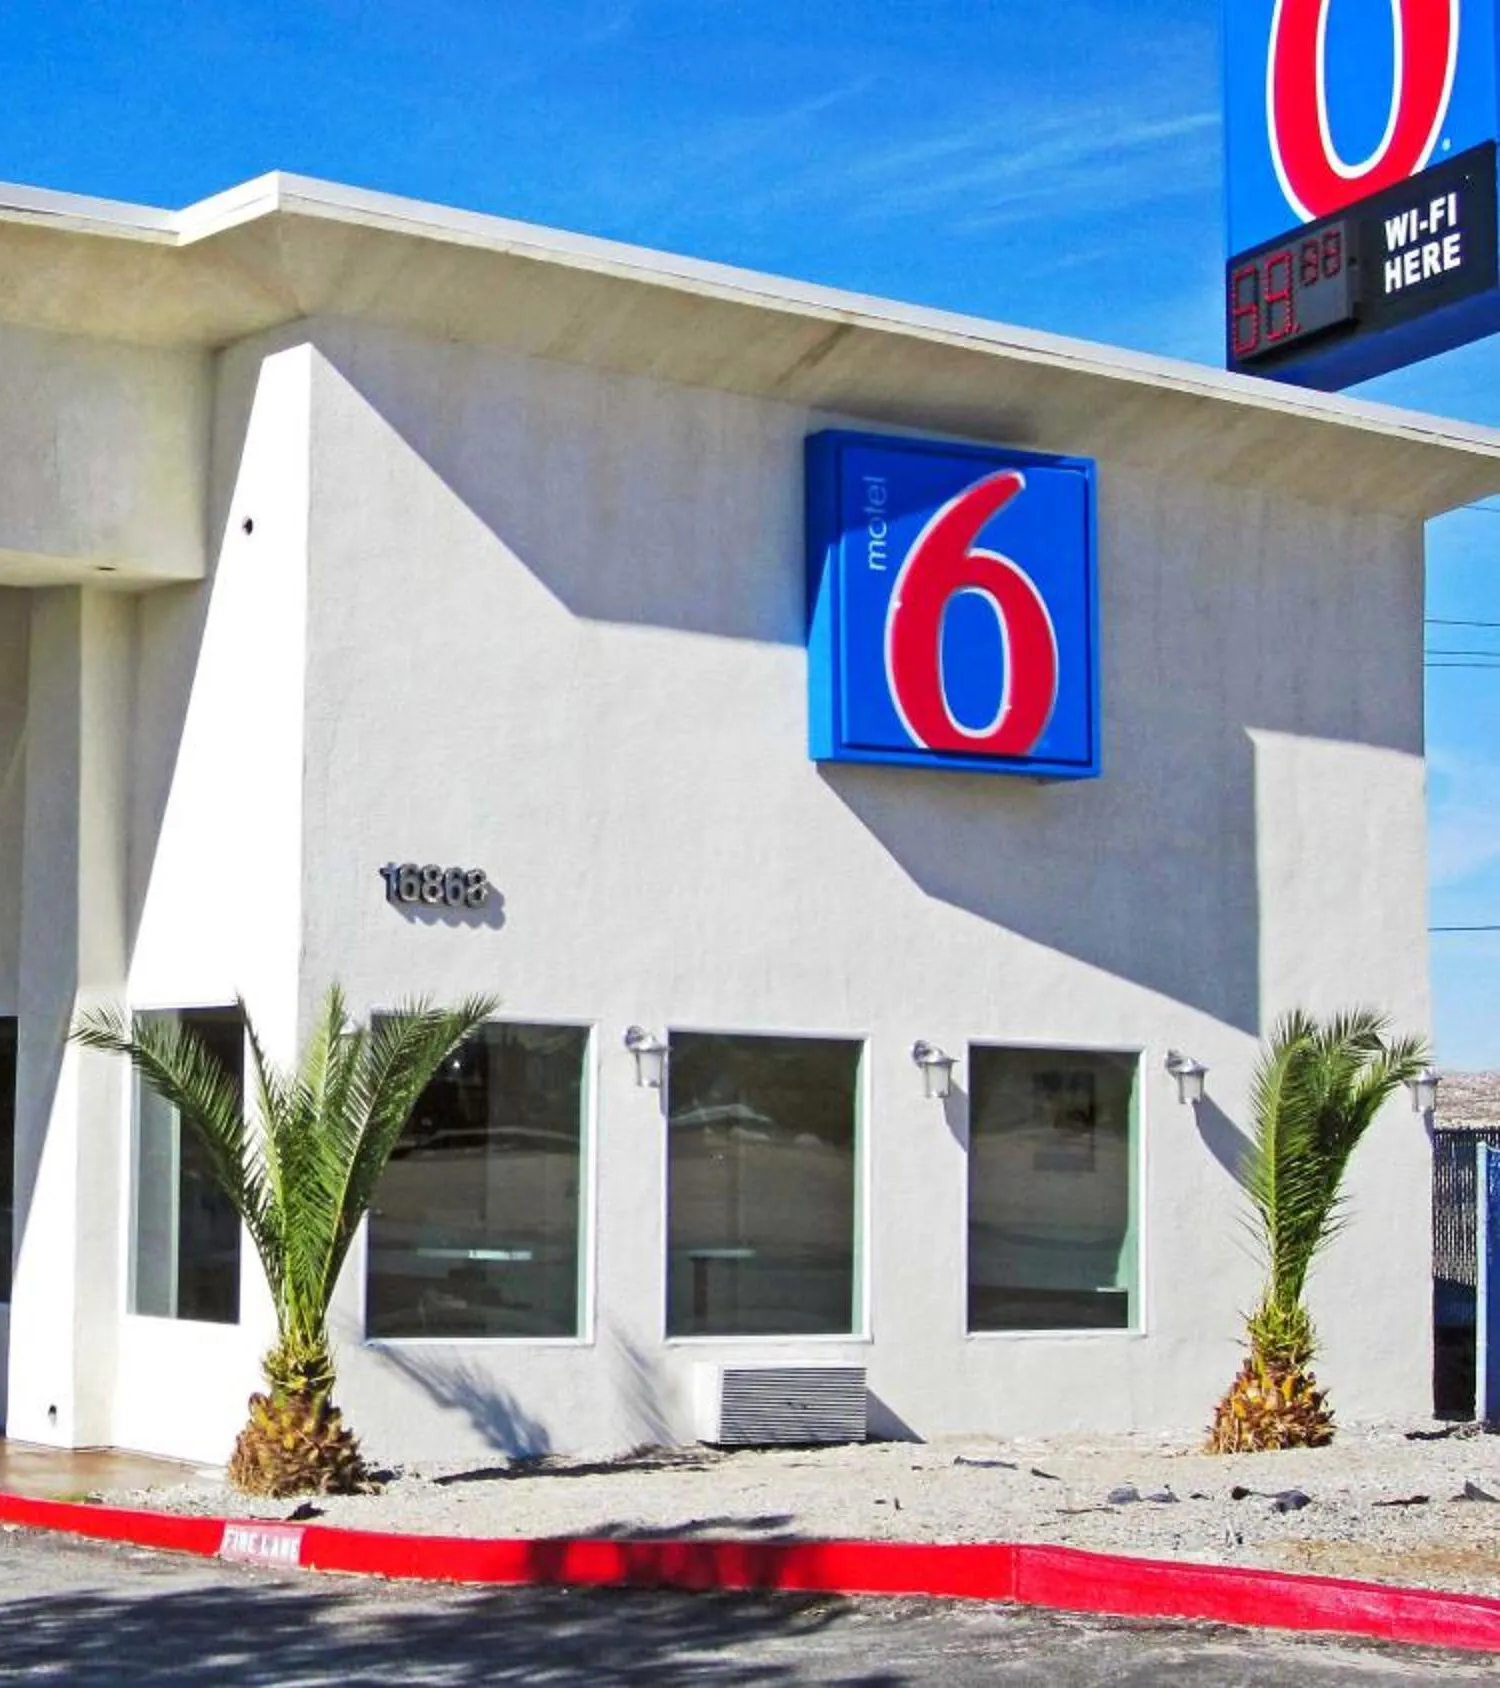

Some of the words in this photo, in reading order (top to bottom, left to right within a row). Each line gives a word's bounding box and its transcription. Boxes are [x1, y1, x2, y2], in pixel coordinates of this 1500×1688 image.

[1384, 192, 1458, 251] WI-FI
[1384, 233, 1461, 294] HERE
[862, 475, 889, 571] motel
[883, 467, 1059, 757] 6
